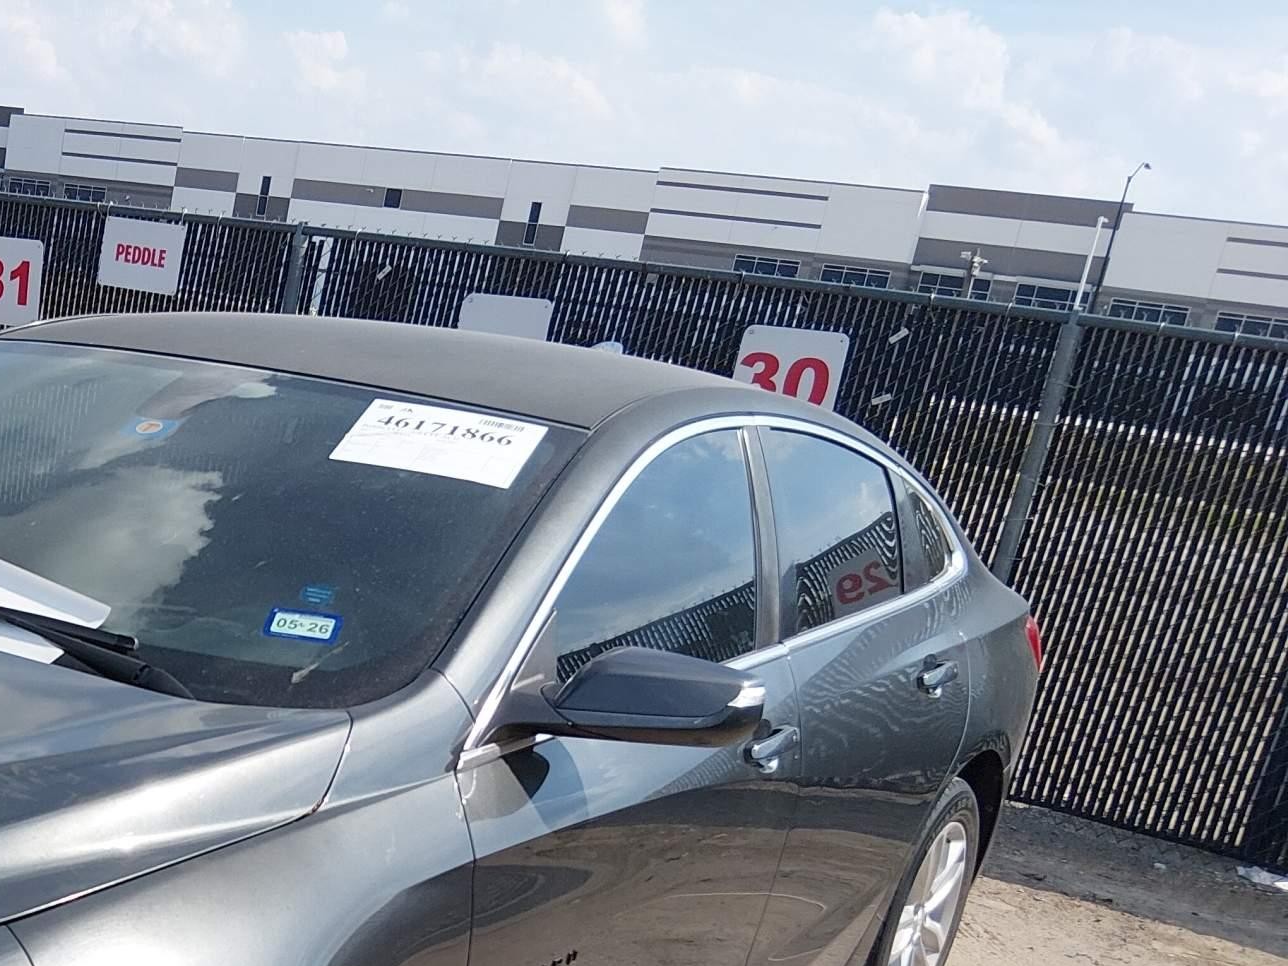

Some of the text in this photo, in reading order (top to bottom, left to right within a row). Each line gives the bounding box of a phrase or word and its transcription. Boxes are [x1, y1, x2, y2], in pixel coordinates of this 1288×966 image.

[114, 243, 167, 268] PEDDLE
[376, 414, 513, 447] 46171866
[276, 617, 330, 635] 05 26
